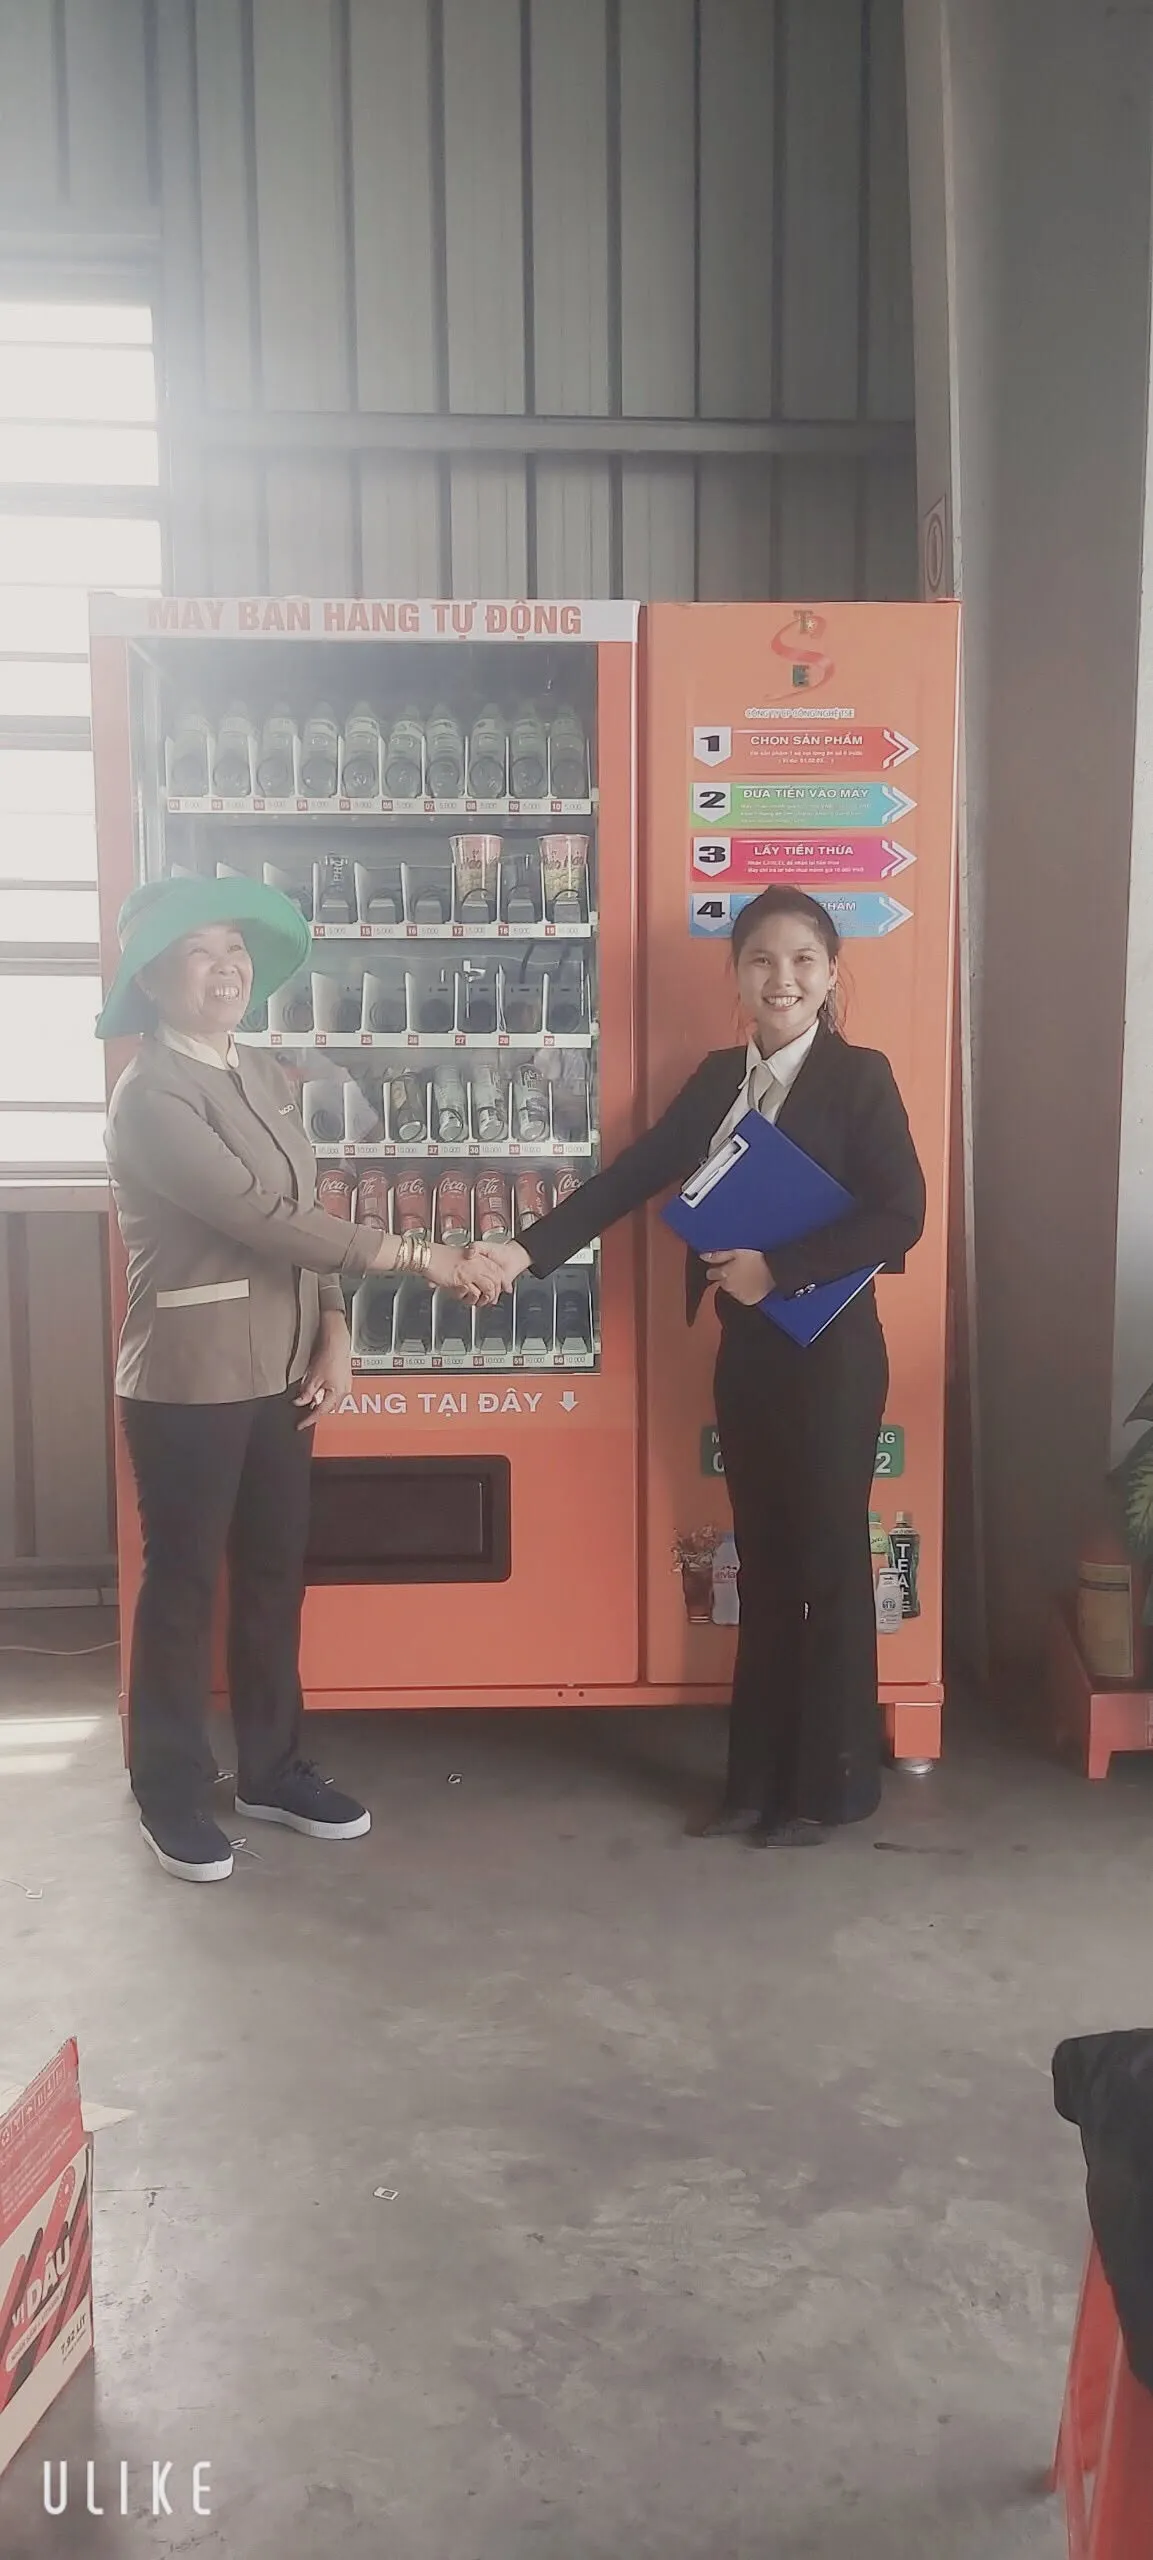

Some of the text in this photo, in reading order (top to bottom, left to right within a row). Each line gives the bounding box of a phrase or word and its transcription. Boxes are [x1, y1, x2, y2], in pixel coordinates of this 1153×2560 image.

[484, 599, 582, 640] ĐỘNG
[700, 735, 720, 751] 1
[699, 791, 726, 808] 2
[698, 845, 726, 863] 3
[696, 901, 726, 918] 4
[417, 1393, 467, 1417] TẠI
[478, 1387, 543, 1413] ĐÂY
[26, 2235, 70, 2319] DÂU
